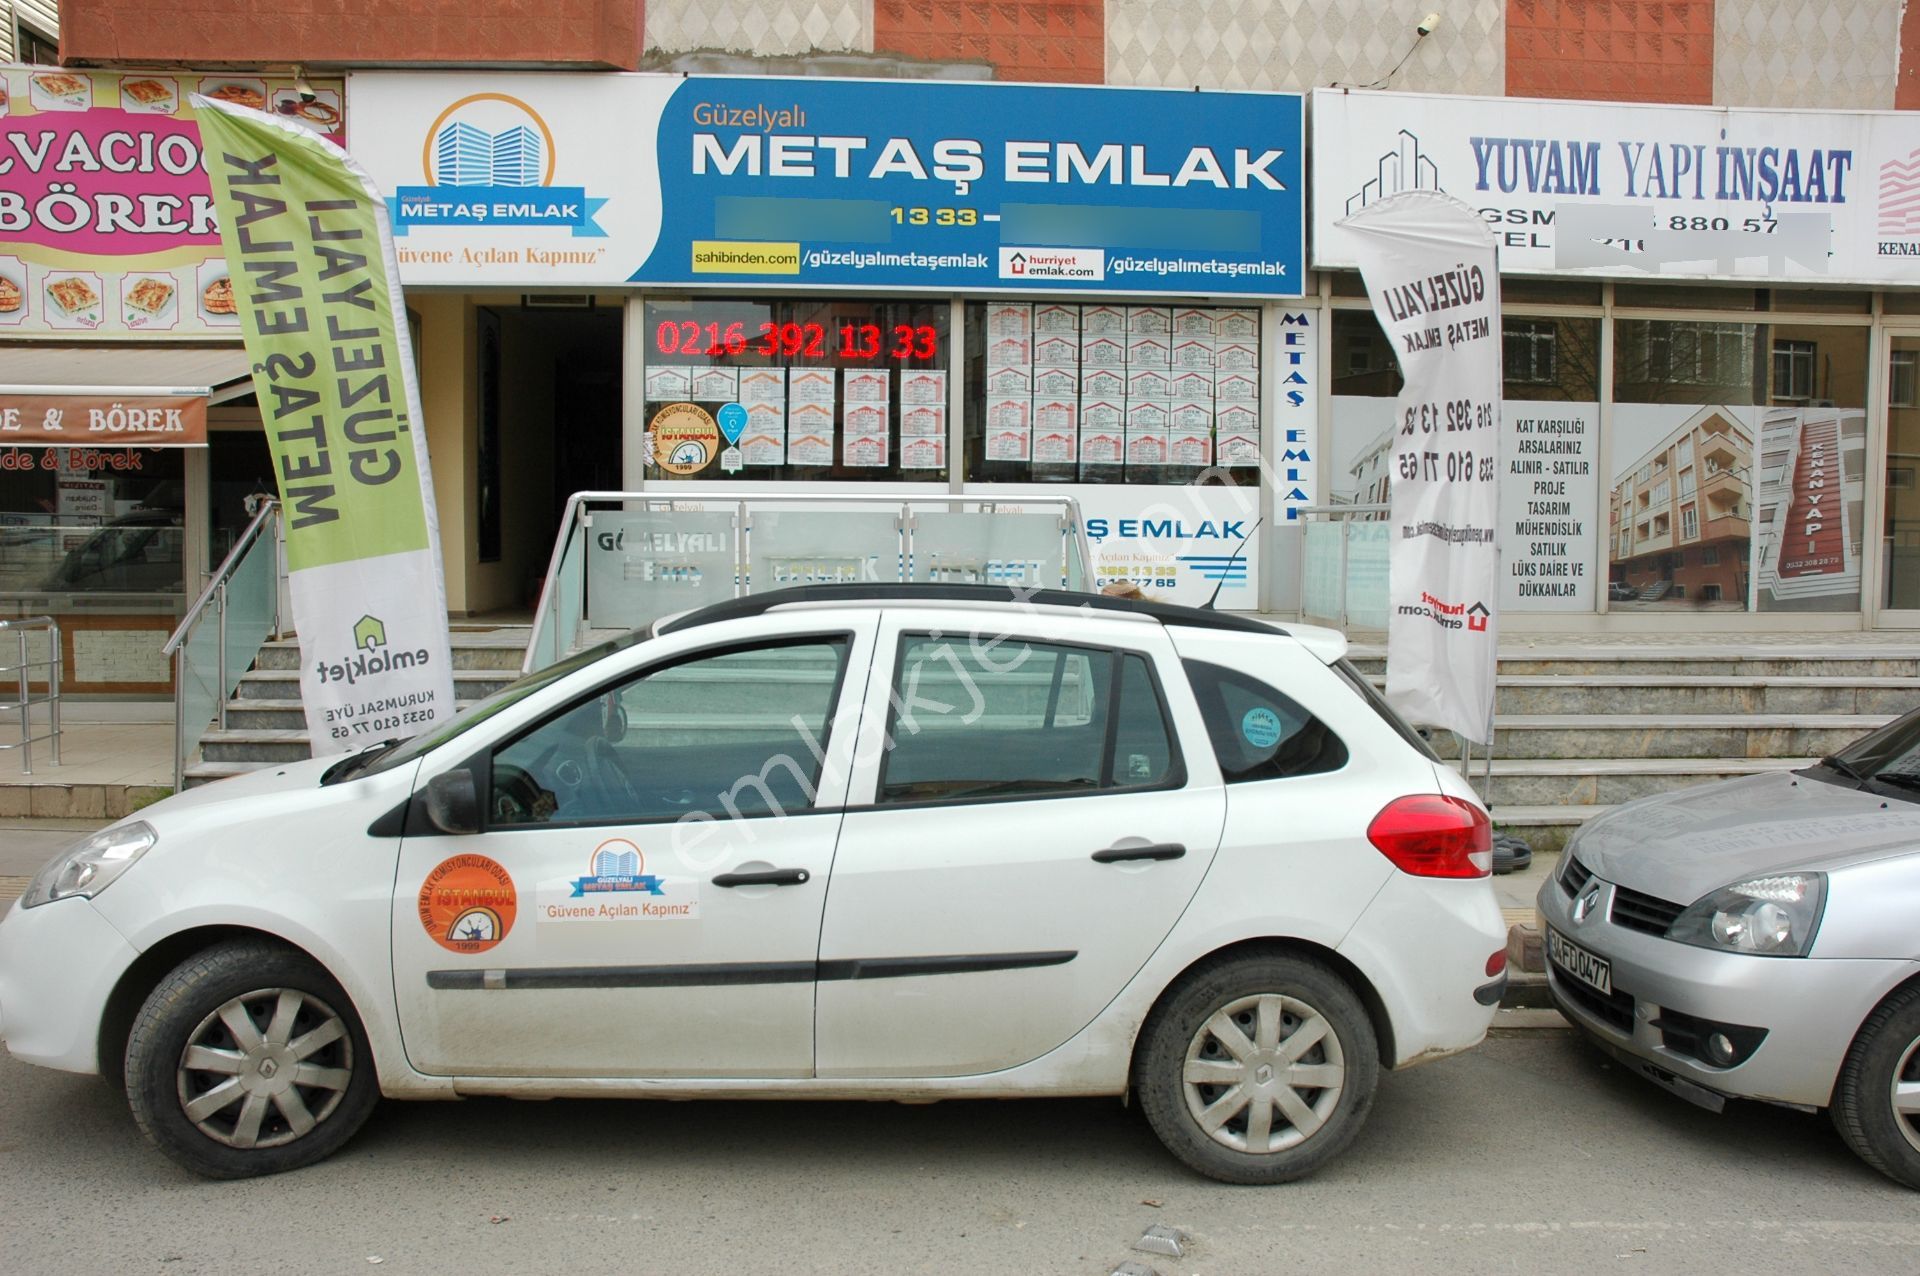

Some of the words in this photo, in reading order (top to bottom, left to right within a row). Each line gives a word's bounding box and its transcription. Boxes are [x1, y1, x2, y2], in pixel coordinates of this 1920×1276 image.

[693, 103, 806, 131] Güzelyalı
[0, 131, 211, 175] VACIO
[692, 134, 985, 196] METAŞ
[1005, 141, 1288, 190] EMLAK
[1470, 136, 1601, 196] YUVAM
[1618, 141, 1707, 200] YAPI
[1716, 128, 1853, 219] İNŞAAT
[401, 203, 488, 221] METAŞ
[493, 204, 579, 218] EMLAK
[1667, 215, 1730, 231] 880
[395, 246, 454, 264] üvene
[459, 247, 520, 268] Açılan
[1878, 242, 1920, 256] KENA
[695, 251, 798, 265] sahibinden.com
[1029, 254, 1077, 267] hurriyet
[1029, 266, 1095, 278] emlak.com
[657, 321, 747, 355] 0216
[758, 322, 826, 358] 392
[840, 323, 881, 359] 13
[891, 324, 937, 360] 33
[0, 407, 22, 431] E
[43, 407, 64, 431] &
[89, 403, 184, 432] BÖREK
[1516, 419, 1534, 434] KAT
[1537, 417, 1585, 437] KARŞILIĞI
[1518, 440, 1582, 455] ARSALARINIZ
[0, 447, 35, 470] de
[41, 447, 60, 470] &
[69, 447, 143, 470] Börek
[1510, 460, 1542, 475] ALINIR
[1553, 461, 1589, 475] SATILIR
[1534, 481, 1565, 495] PROJE
[1527, 501, 1571, 516] TASARIM
[1118, 519, 1245, 539] EMLAK
[1515, 519, 1583, 536] MÜHENDİSLİK
[1530, 542, 1567, 556] SATILIK
[1512, 560, 1537, 576] LÜKS
[1540, 560, 1568, 576] DAİRE
[1571, 562, 1584, 576] VE
[1518, 580, 1576, 597] DÜKKANLAR
[599, 904, 639, 919] Açılan
[456, 942, 480, 950] 1999
